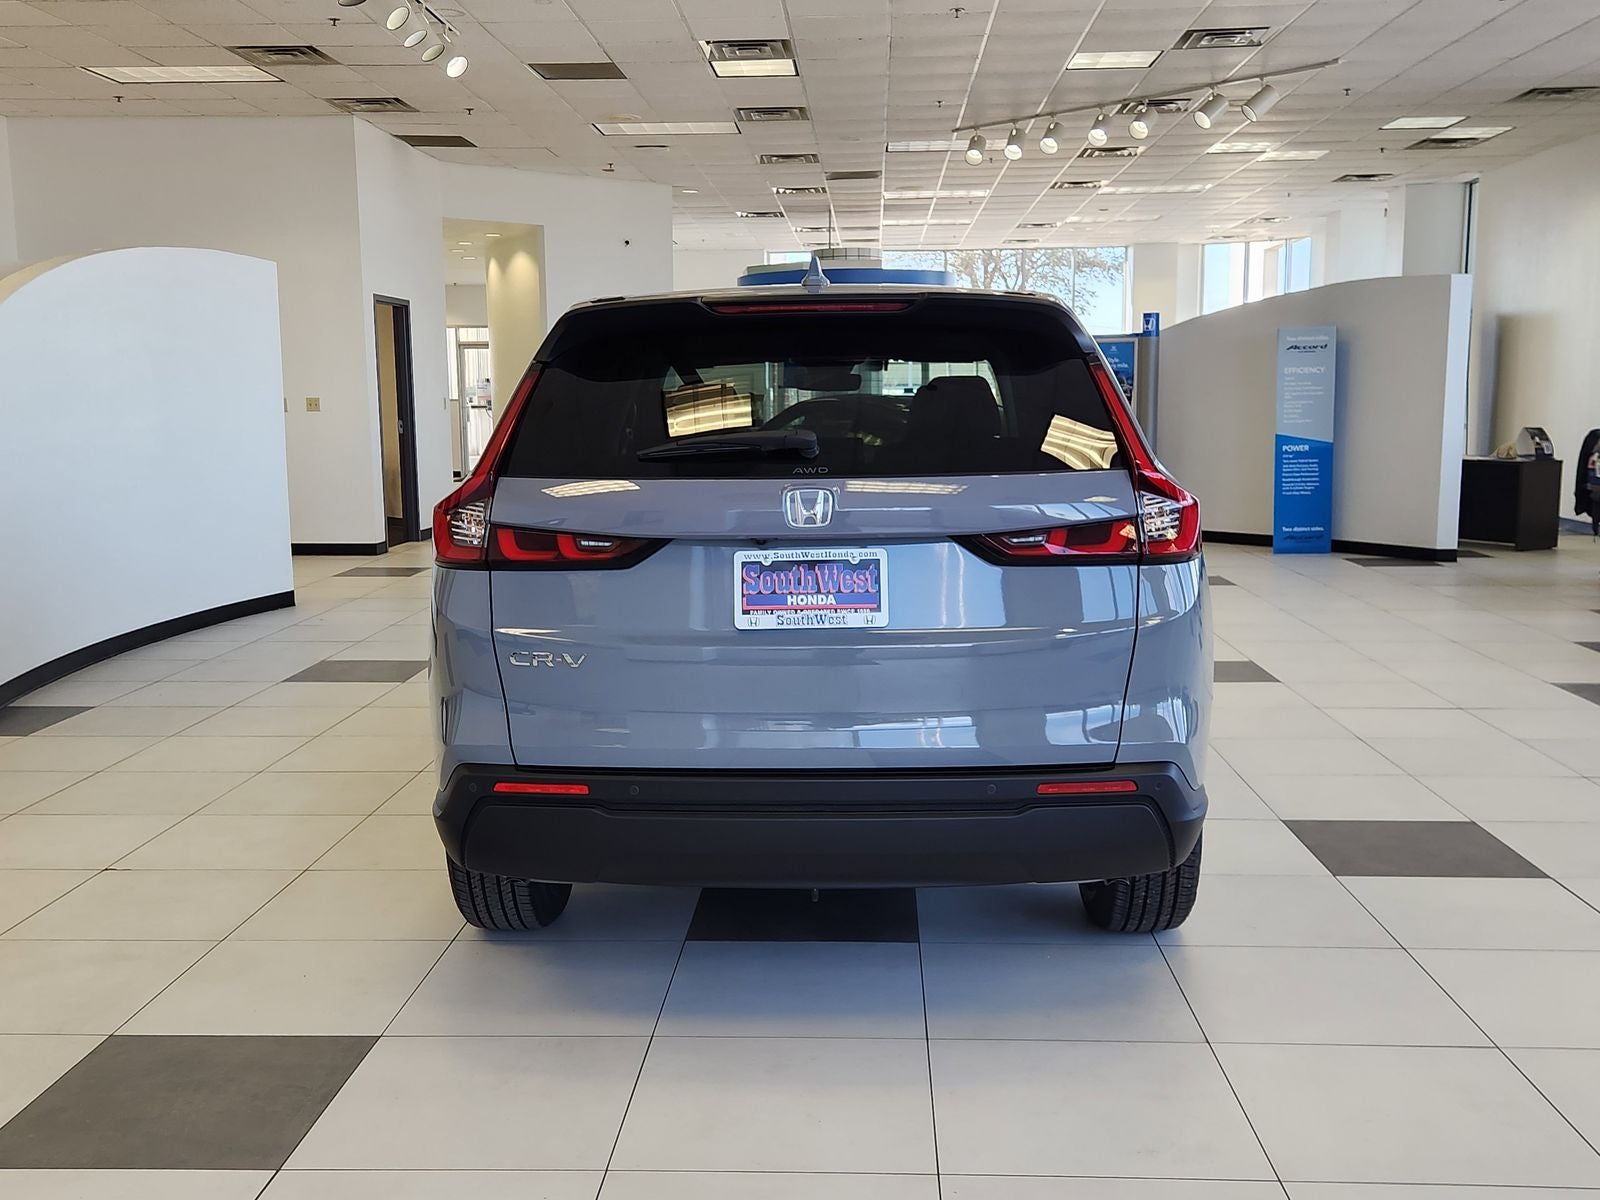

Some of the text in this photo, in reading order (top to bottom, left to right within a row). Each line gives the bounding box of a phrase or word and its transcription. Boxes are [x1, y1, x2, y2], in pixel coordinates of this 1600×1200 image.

[1286, 343, 1328, 351] Accord
[743, 551, 878, 560] www.SouthWestHonda.com
[743, 563, 879, 595] SouthWest
[787, 594, 837, 606] HONDA
[777, 614, 847, 626] SouthWest
[509, 651, 587, 668] CR-V
